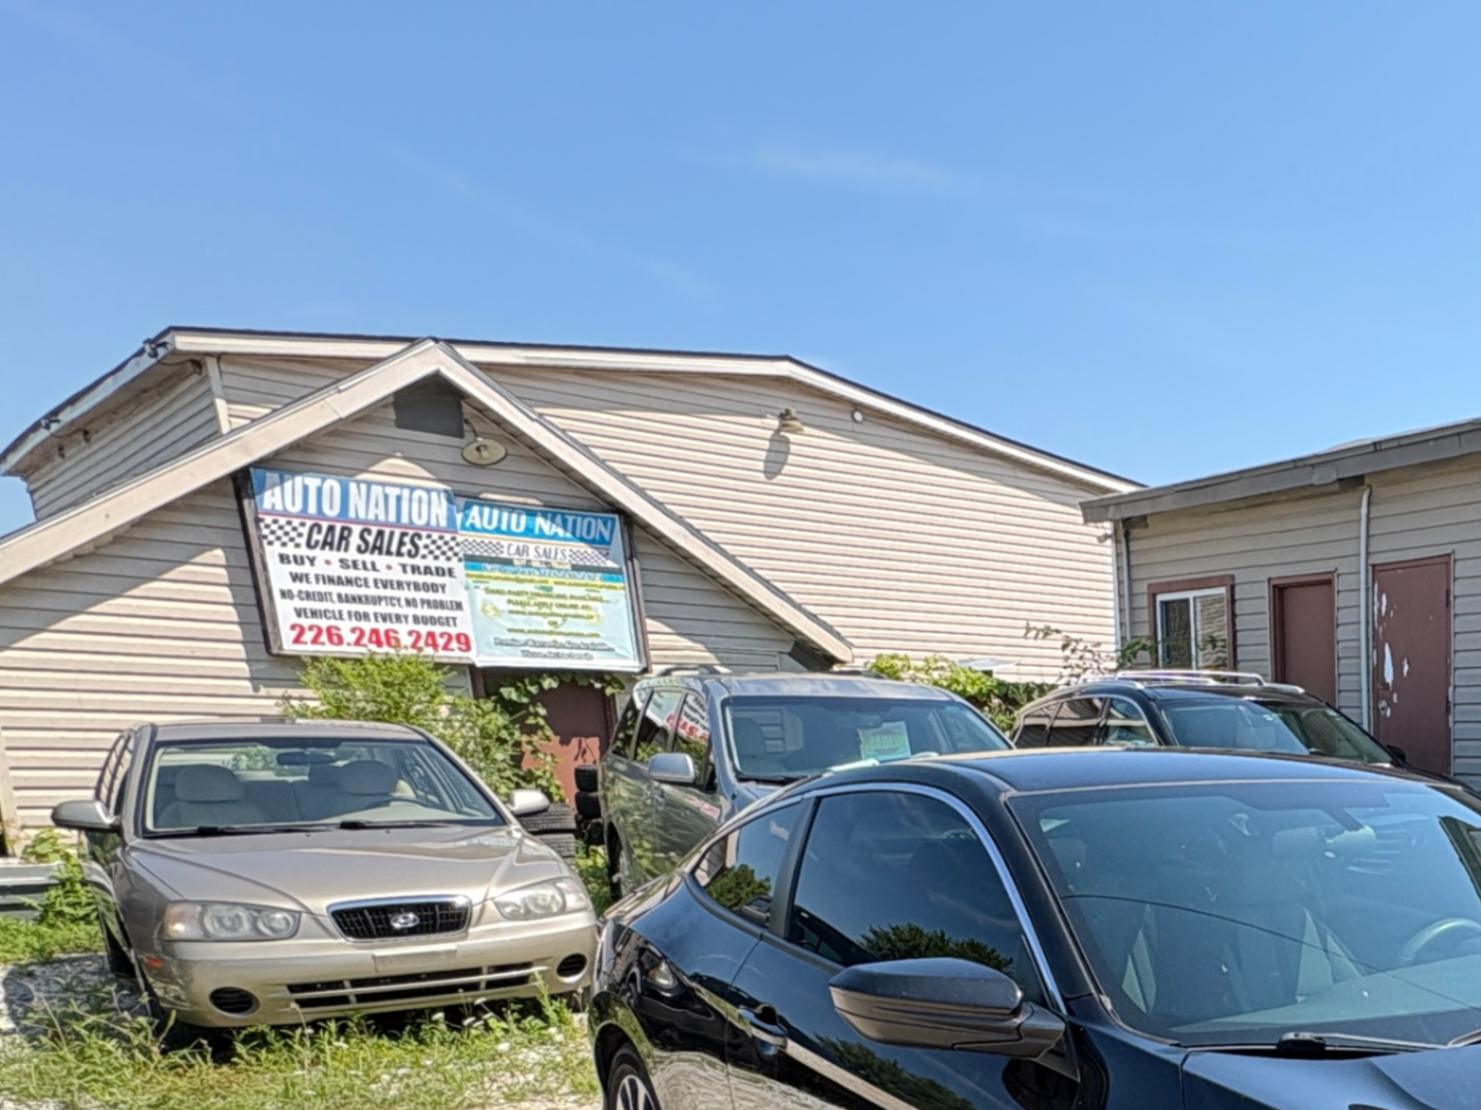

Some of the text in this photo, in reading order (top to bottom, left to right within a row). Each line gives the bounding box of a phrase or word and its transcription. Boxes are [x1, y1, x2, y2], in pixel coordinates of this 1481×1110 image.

[262, 472, 447, 528] AUTO NATION
[465, 504, 612, 542] AUTO NATION
[306, 522, 423, 559] CAR SALES
[507, 543, 569, 561] CAR SALES
[278, 553, 457, 578] BUY SELL TRADE
[289, 571, 312, 584] WE
[314, 573, 371, 589] FINANCE
[373, 577, 447, 594] EVERYBODY
[293, 606, 457, 628] VEHICLE FOR EVERY BUDGET
[405, 597, 418, 609] NO
[420, 598, 464, 612] PROBLEM
[289, 622, 472, 652] 226.246.2429
